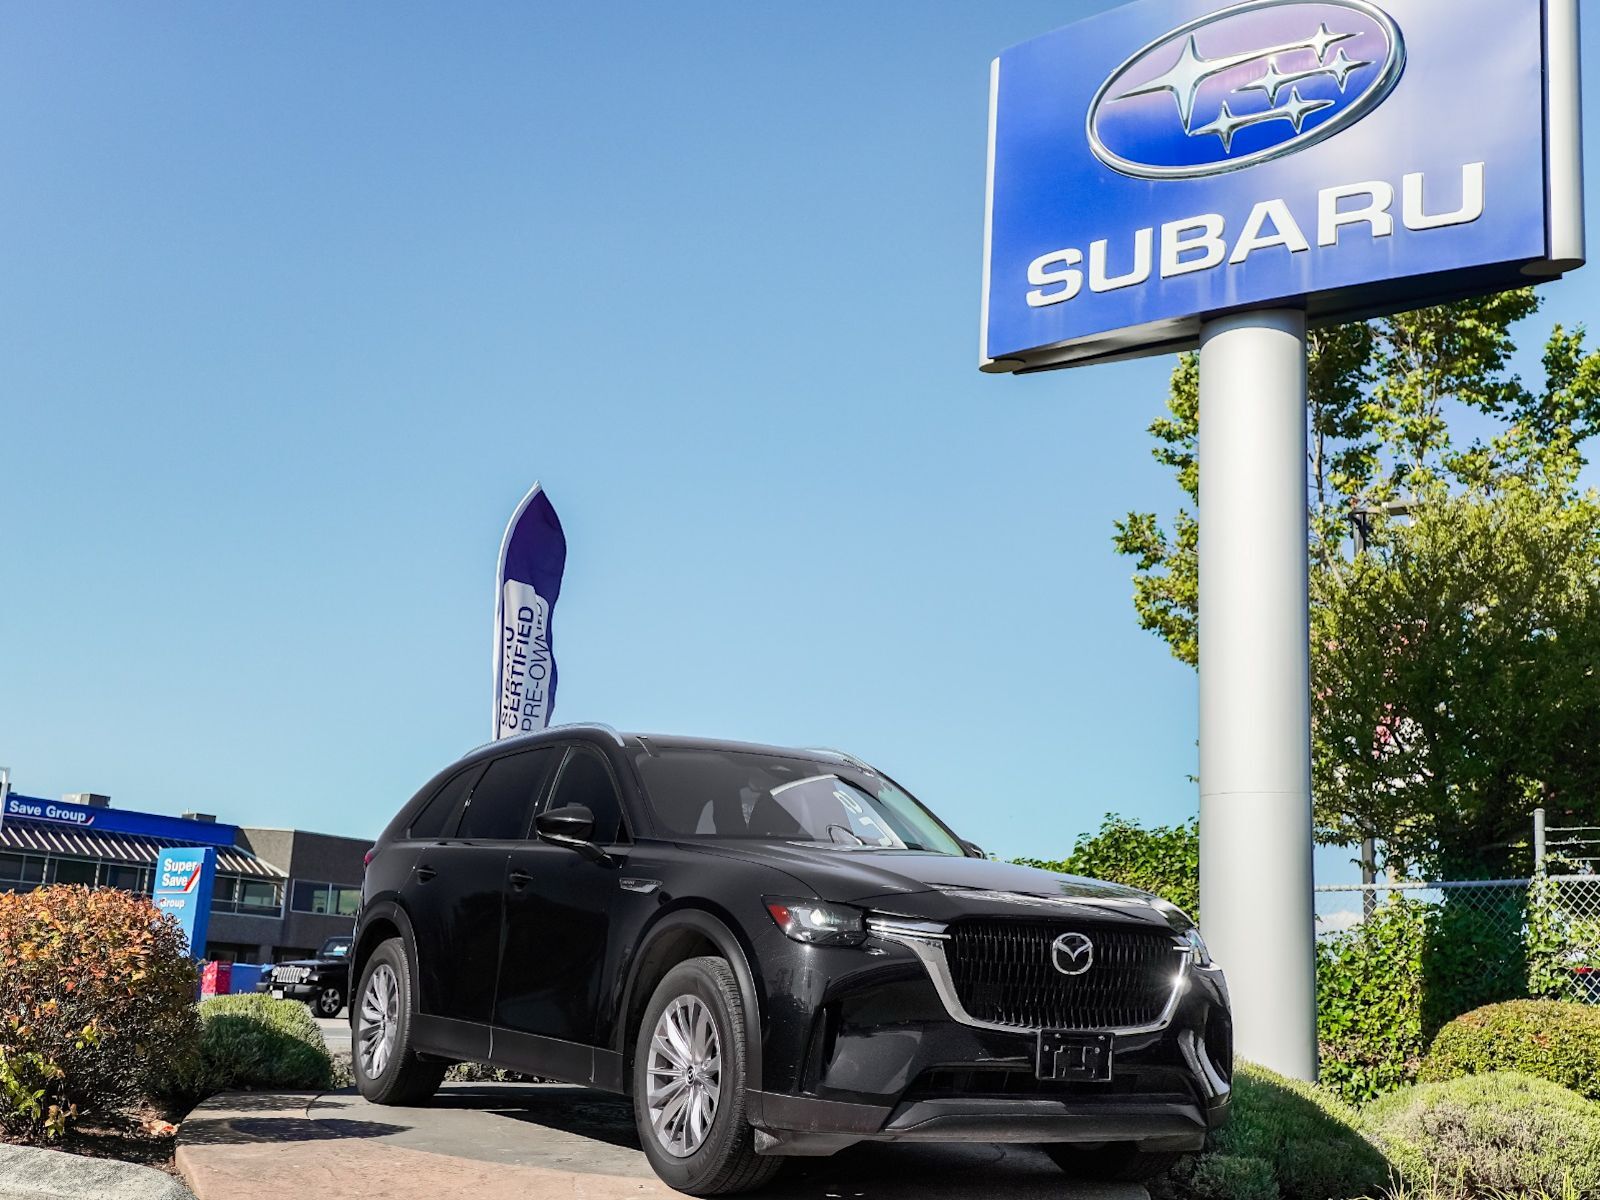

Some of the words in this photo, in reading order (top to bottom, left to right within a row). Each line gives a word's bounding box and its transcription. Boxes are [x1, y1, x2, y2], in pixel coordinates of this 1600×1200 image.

[1026, 161, 1485, 307] SUBARU
[508, 606, 534, 729] CERTIFIED
[9, 800, 42, 815] Save
[46, 805, 86, 824] Group
[163, 858, 198, 874] Super
[161, 873, 188, 887] Save
[159, 897, 185, 909] Group
